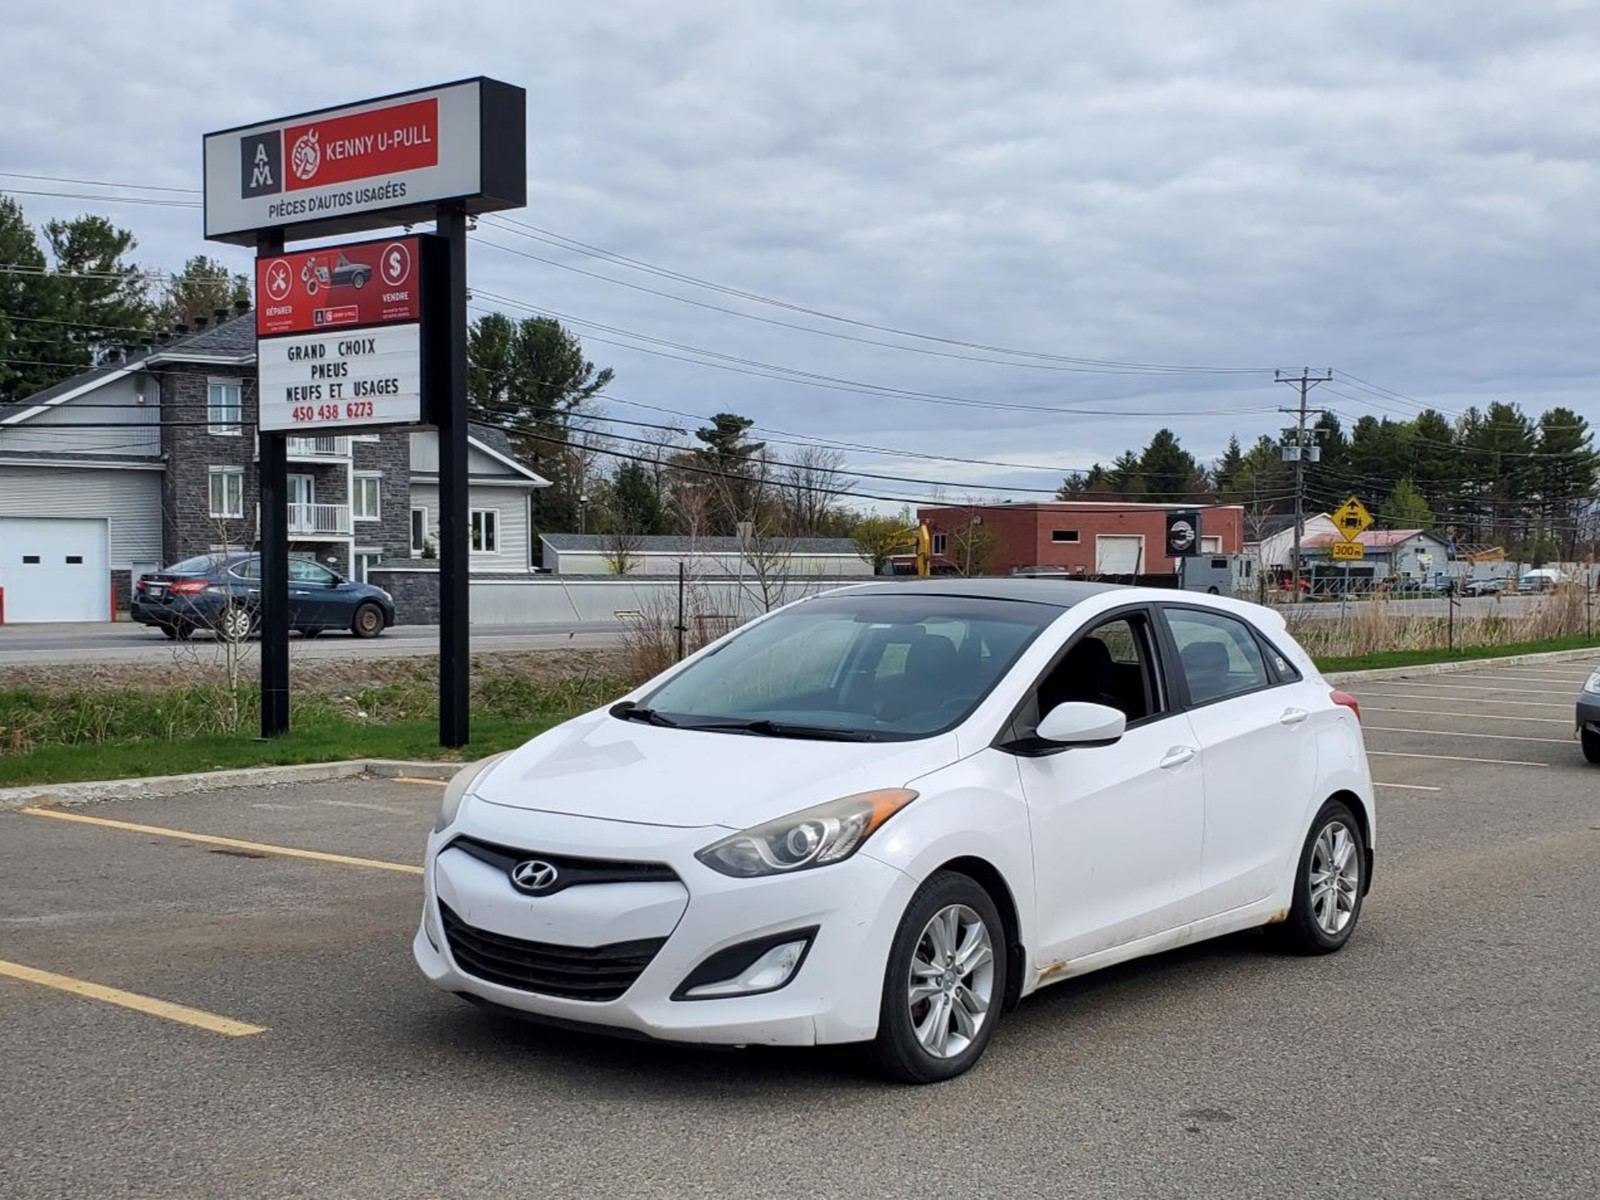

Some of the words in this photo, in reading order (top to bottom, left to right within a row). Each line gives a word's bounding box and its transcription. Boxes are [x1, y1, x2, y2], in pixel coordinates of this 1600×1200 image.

[326, 134, 374, 161] KENNY
[377, 124, 432, 151] U-PULL
[268, 199, 306, 218] PIÈCES
[308, 191, 353, 212] D'AUTOS
[355, 181, 407, 204] USAGÉES
[382, 291, 409, 302] VENDRE
[287, 343, 326, 361] GRAND
[338, 338, 376, 356] CHOIX
[311, 362, 348, 379] PNEUS
[286, 384, 322, 402] NEUFS
[329, 383, 343, 398] ET
[354, 378, 399, 396] USAGES
[292, 406, 314, 422] 450
[318, 404, 339, 420] 438
[346, 402, 373, 418] 6273
[1335, 545, 1354, 556] 300
